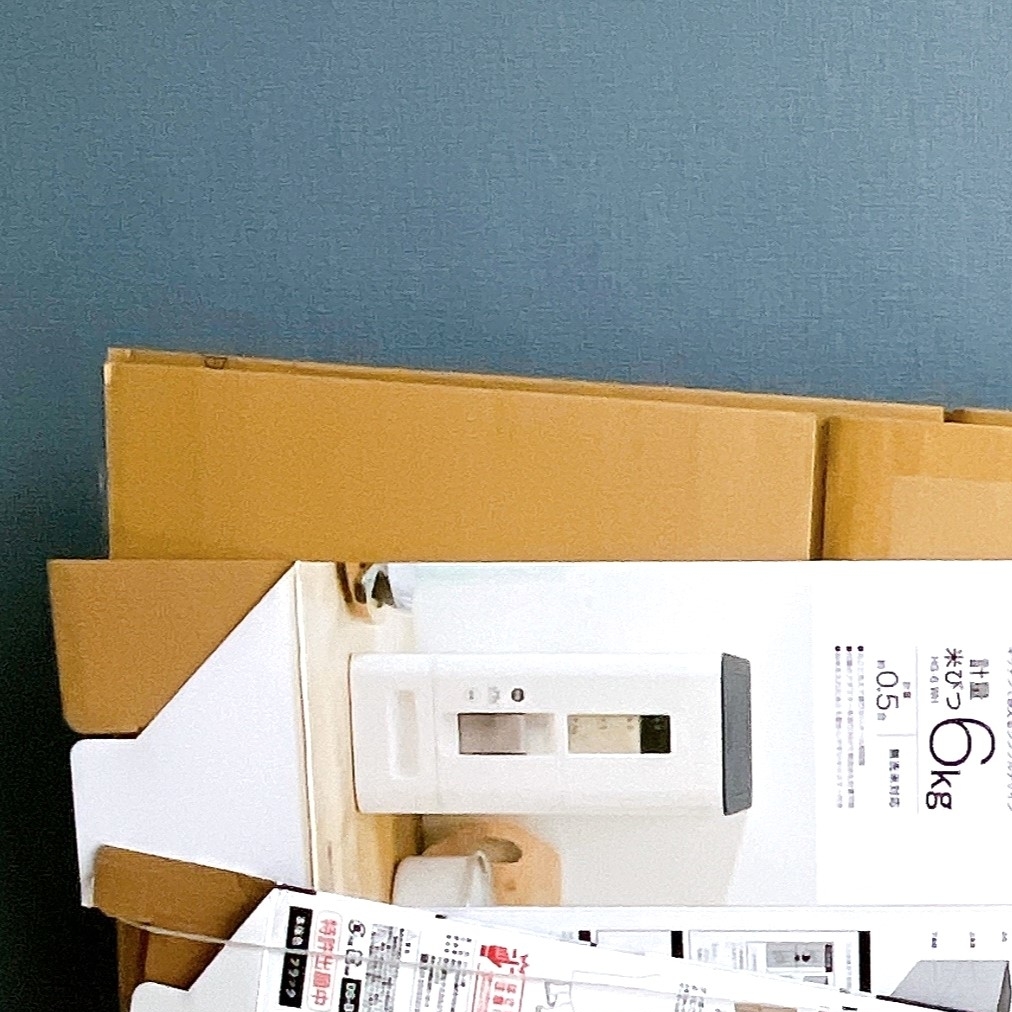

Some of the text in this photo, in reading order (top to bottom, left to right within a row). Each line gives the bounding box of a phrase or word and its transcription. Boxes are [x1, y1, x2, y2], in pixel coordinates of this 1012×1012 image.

[944, 648, 964, 710] 米びつ
[969, 659, 990, 700] 計量
[926, 718, 996, 810] 6kg
